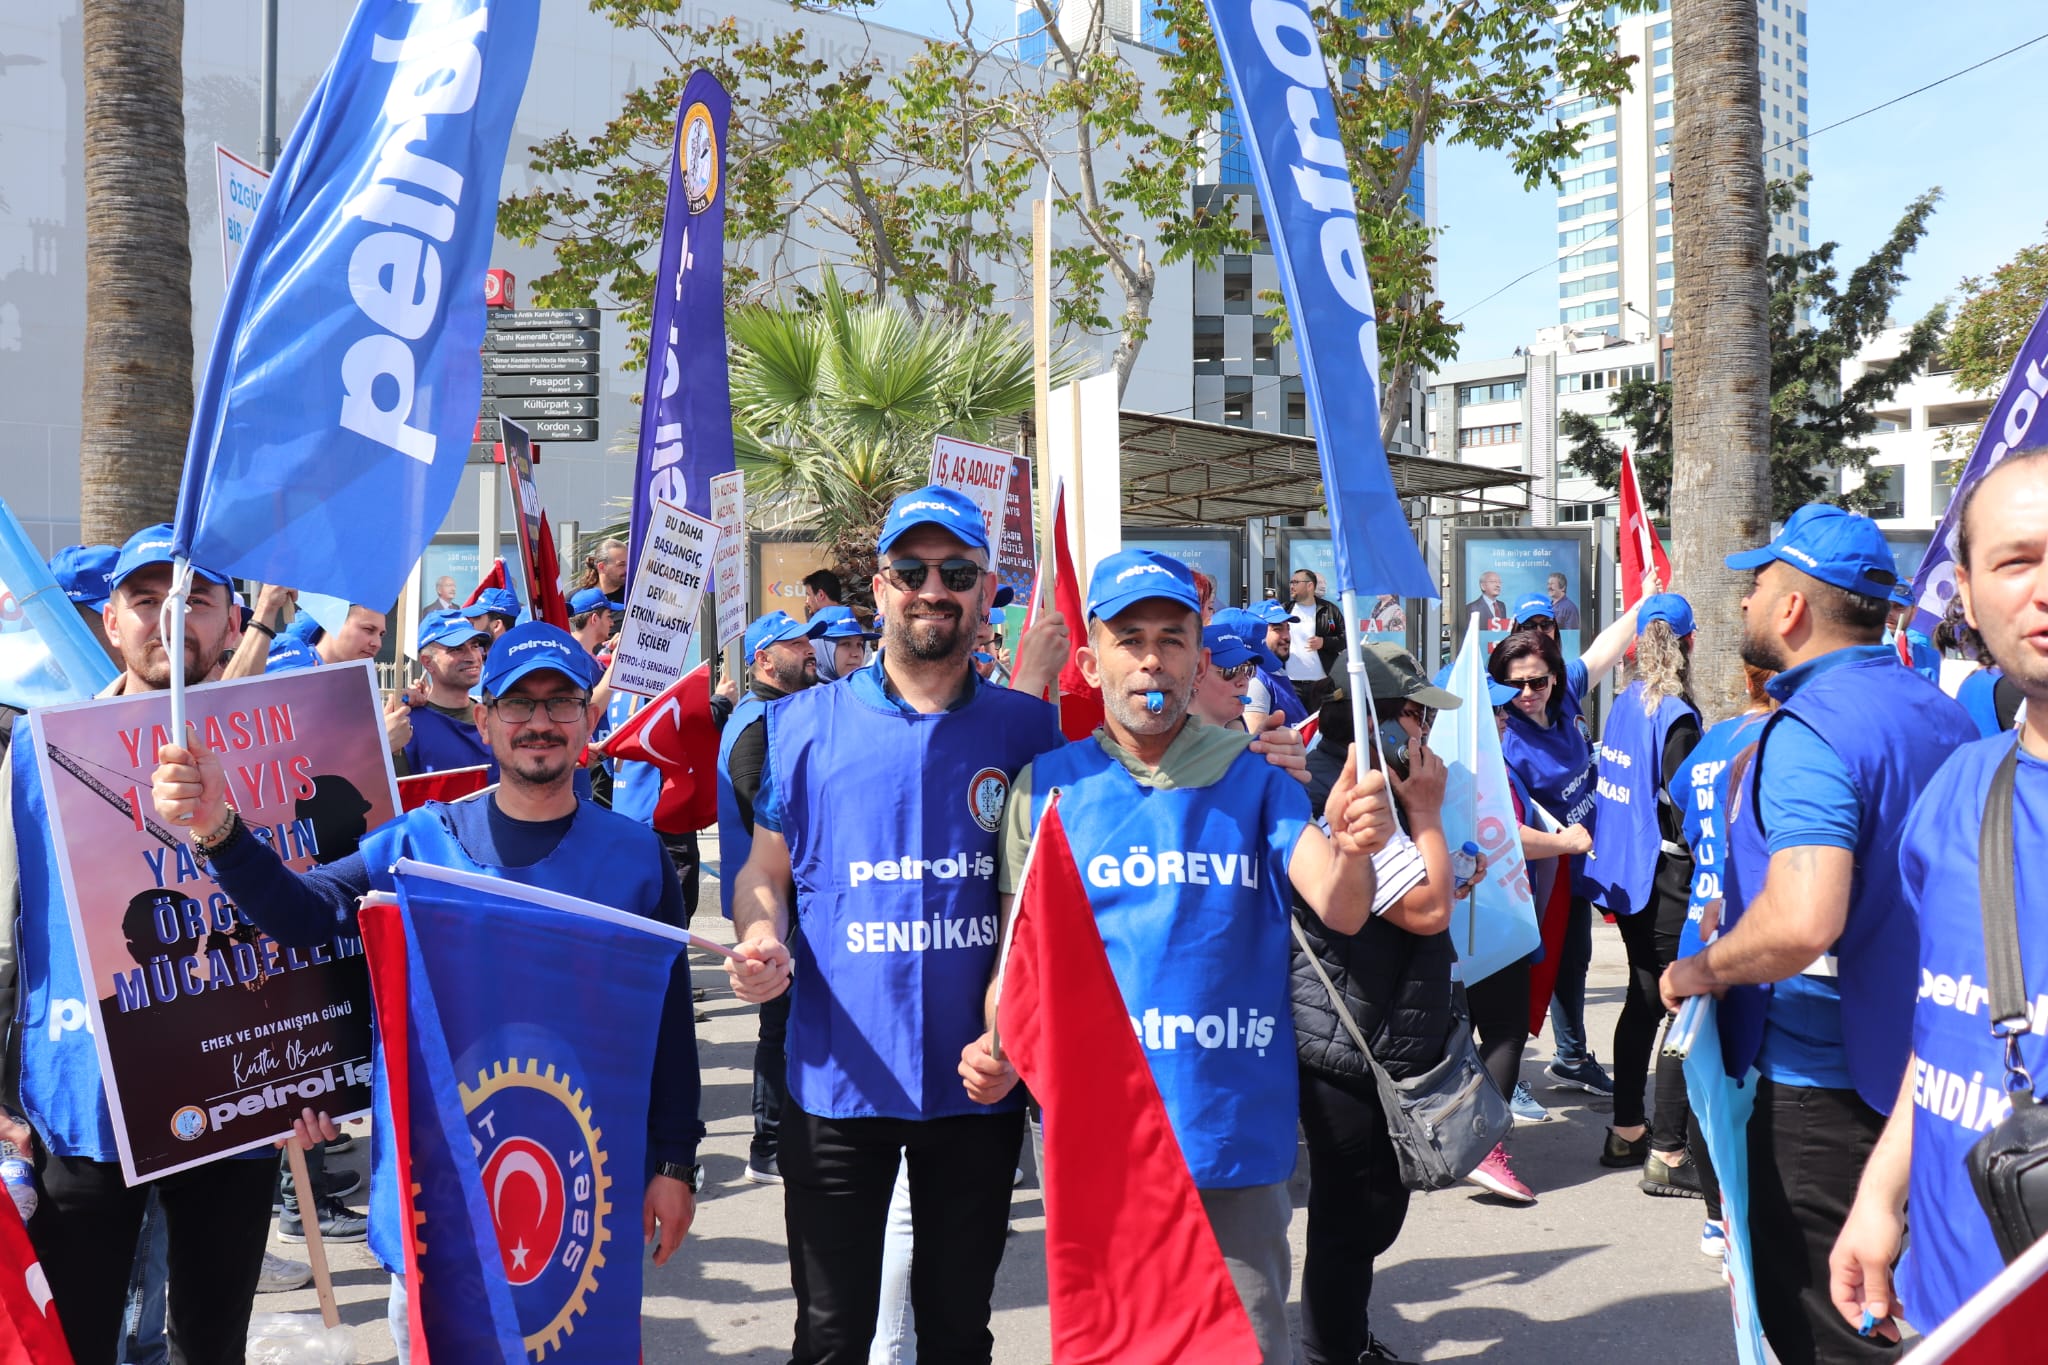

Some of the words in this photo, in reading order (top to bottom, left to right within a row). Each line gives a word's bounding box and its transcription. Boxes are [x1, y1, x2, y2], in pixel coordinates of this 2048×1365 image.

[529, 377, 570, 389] Pasaport
[523, 400, 570, 411] Kültürpark
[537, 422, 570, 431] Kordon
[936, 445, 949, 487] İŞ,
[951, 455, 967, 490] AŞ
[967, 459, 1006, 491] ADALET
[665, 514, 678, 532] BU
[678, 518, 704, 542] DAHA
[653, 535, 703, 570] BAŞLANGIÇ,
[1532, 548, 1553, 557] dolar
[645, 555, 701, 590] MÜCADELEYE
[630, 603, 655, 626] ETKİN
[656, 611, 692, 636] PLASTİK
[508, 640, 571, 657] petrol-iş
[617, 652, 646, 669] PETROL-İŞ
[646, 659, 679, 677] SENDİKASI
[620, 672, 645, 687] MANİSA
[117, 704, 297, 769] YAASIN
[849, 852, 995, 888] petrol-iş
[1696, 872, 1724, 899] OL
[846, 912, 998, 954] SENDİKASI
[112, 935, 364, 1014] MÜCADELEM
[200, 1033, 234, 1054] EMEK
[236, 1029, 252, 1044] VE
[253, 1012, 320, 1039] DAYANIŞMA
[321, 1000, 353, 1020] GÜNÜ
[1128, 1007, 1276, 1058] trol-iş
[232, 1047, 281, 1090] Kutlu
[208, 1061, 373, 1132] petrol-iş
